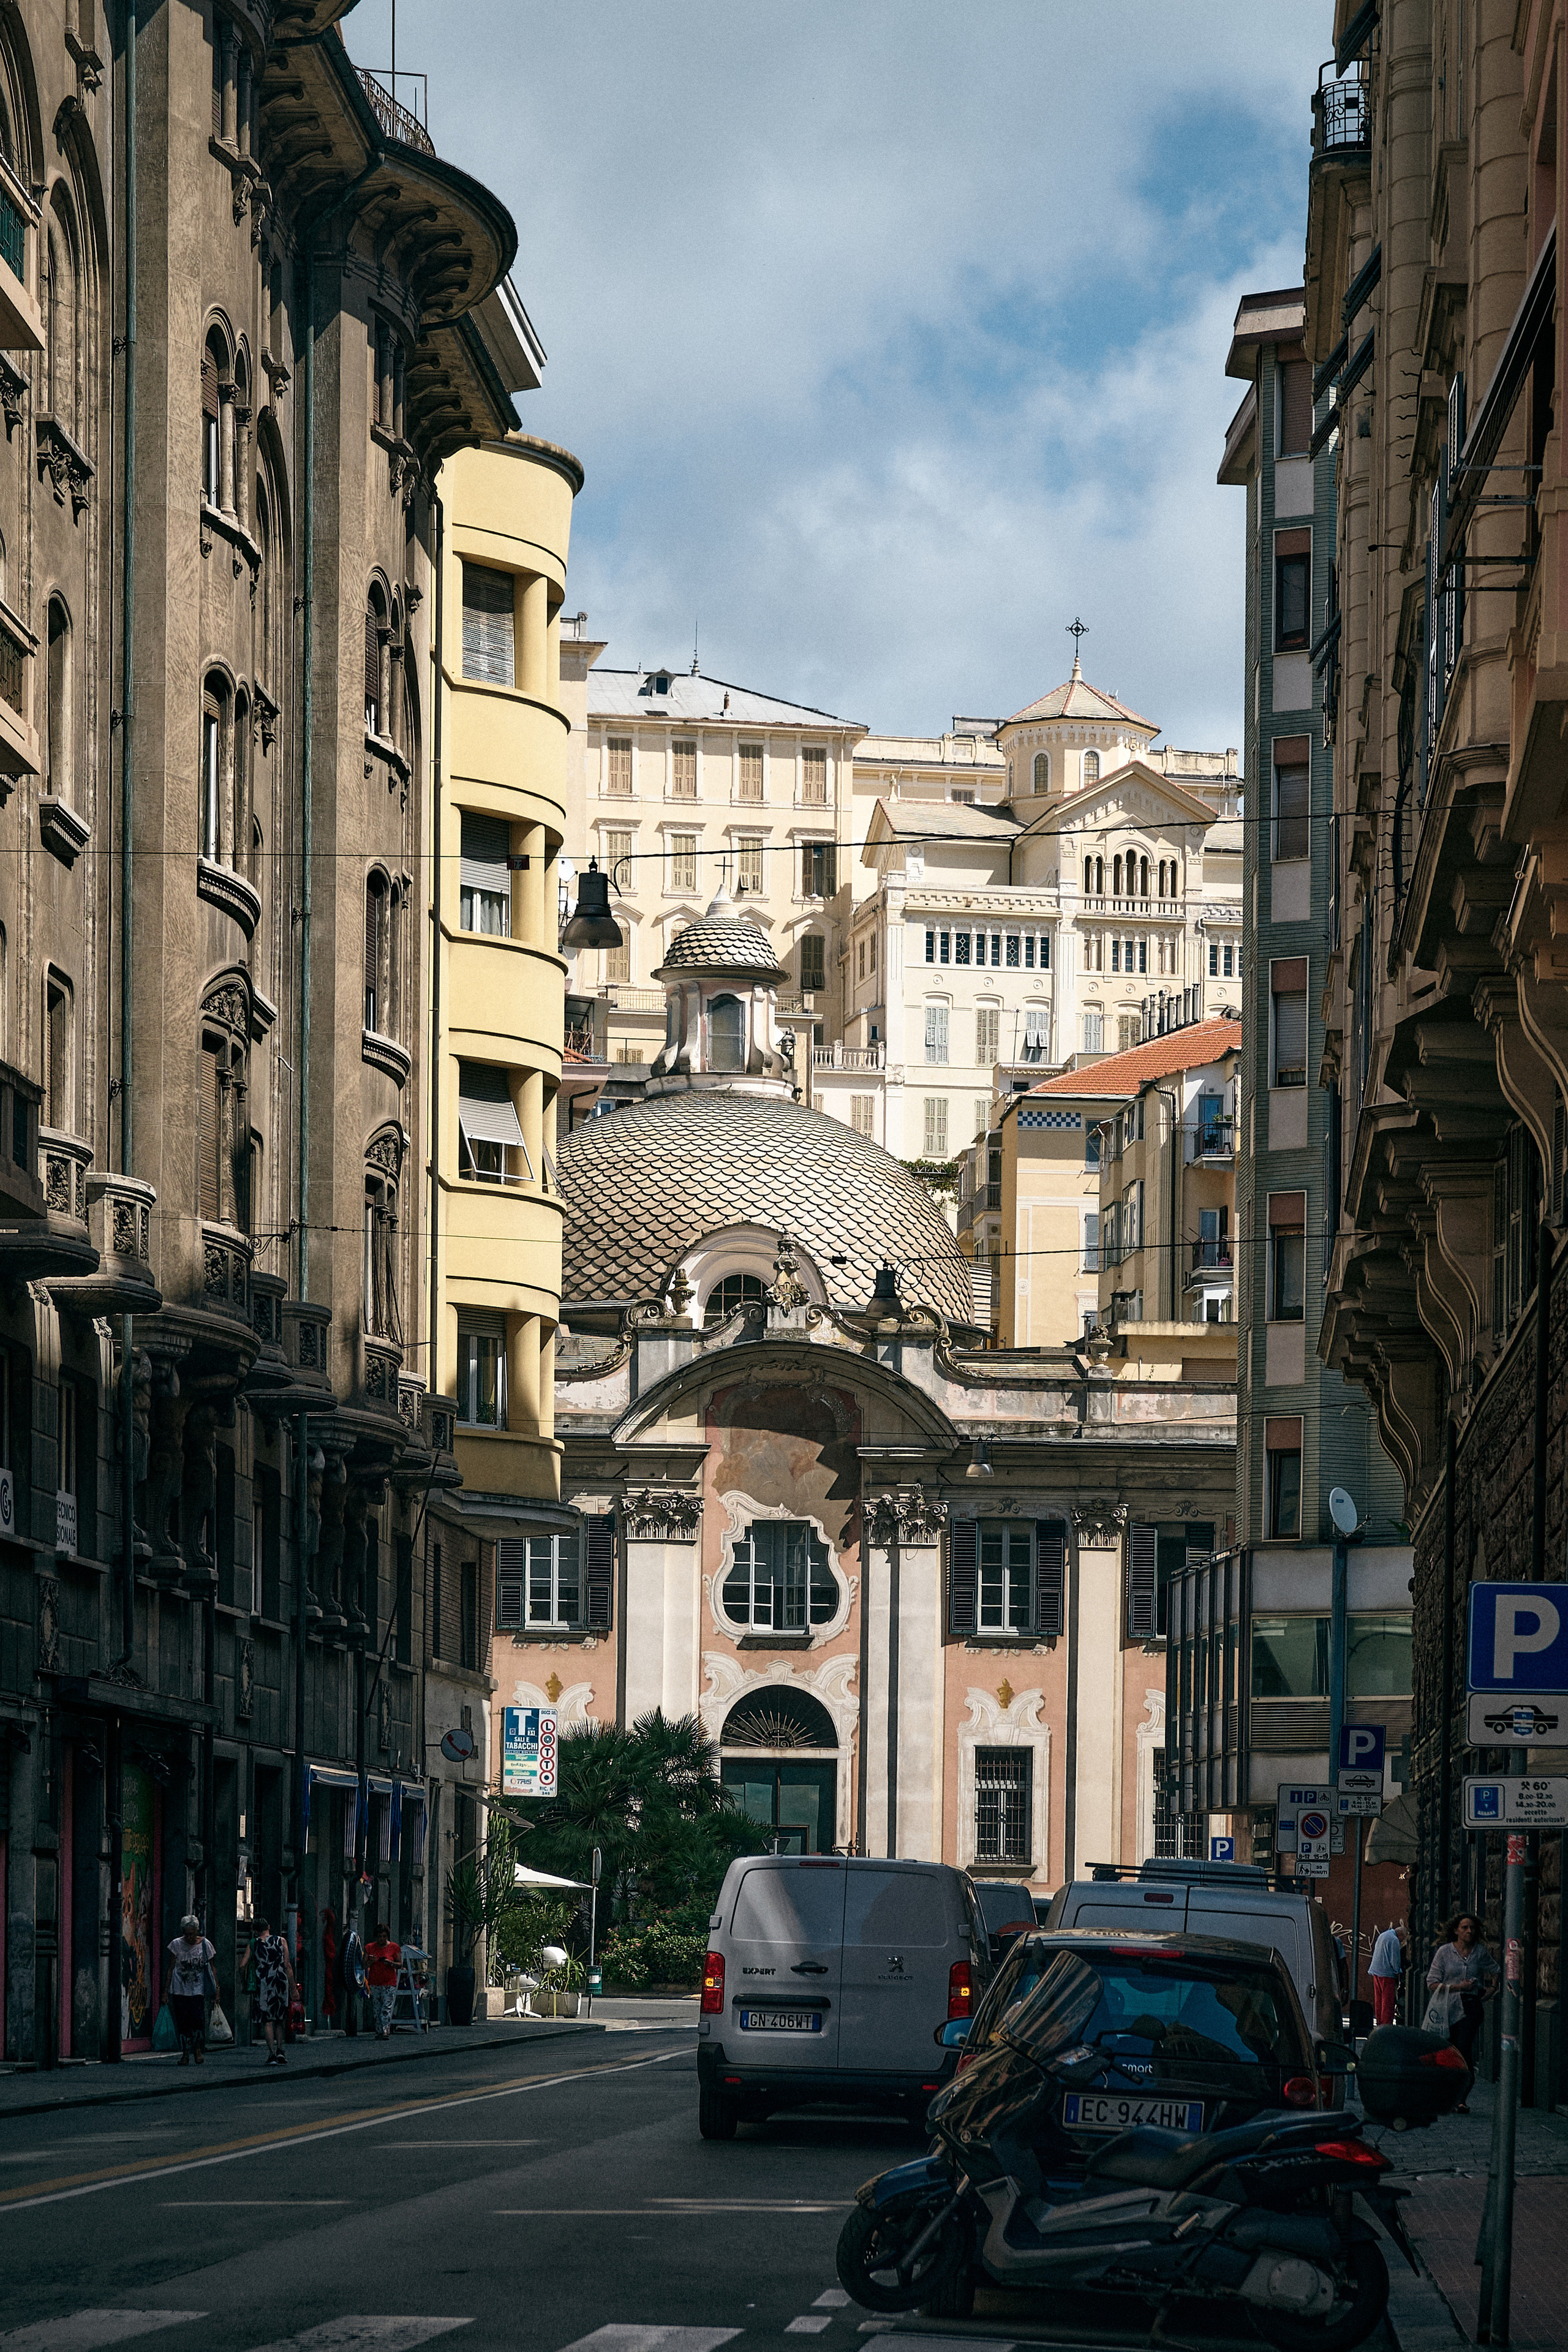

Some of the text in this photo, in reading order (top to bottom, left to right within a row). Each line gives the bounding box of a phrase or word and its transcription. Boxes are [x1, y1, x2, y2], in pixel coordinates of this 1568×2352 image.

[1493, 1594, 1560, 1679] P
[513, 1709, 532, 1735] T
[1348, 1730, 1376, 1765] P
[1306, 1793, 1314, 1801] P
[1483, 1791, 1490, 1800] P
[1216, 1840, 1229, 1858] P
[750, 2013, 766, 2027] GN
[771, 2014, 812, 2029] 406WT
[1082, 2099, 1108, 2122] EC
[1118, 2101, 1187, 2128] 944HW
